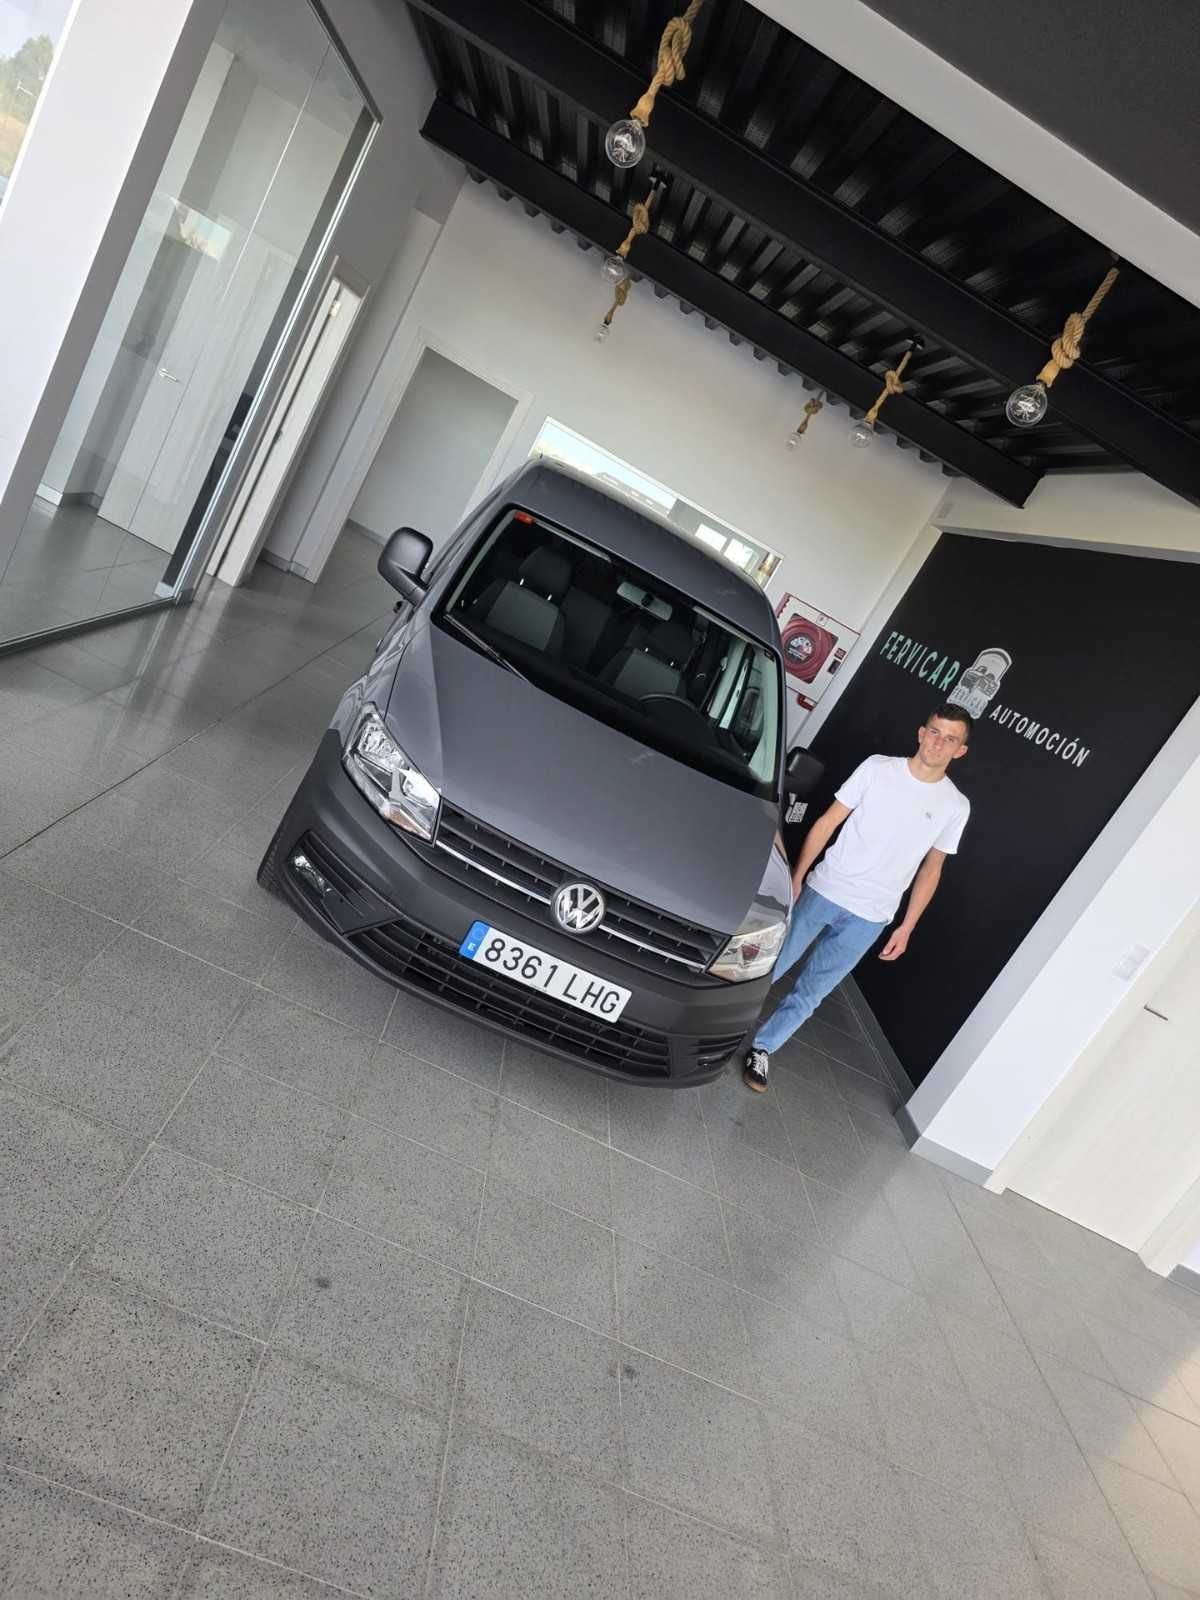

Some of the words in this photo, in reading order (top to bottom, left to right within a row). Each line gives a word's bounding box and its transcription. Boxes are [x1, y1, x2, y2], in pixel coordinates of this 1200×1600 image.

[879, 631, 961, 691] FERVICAR
[988, 704, 1091, 767] AUTOMOCIÓN
[484, 938, 560, 988] 8361
[562, 973, 620, 1014] LHG
